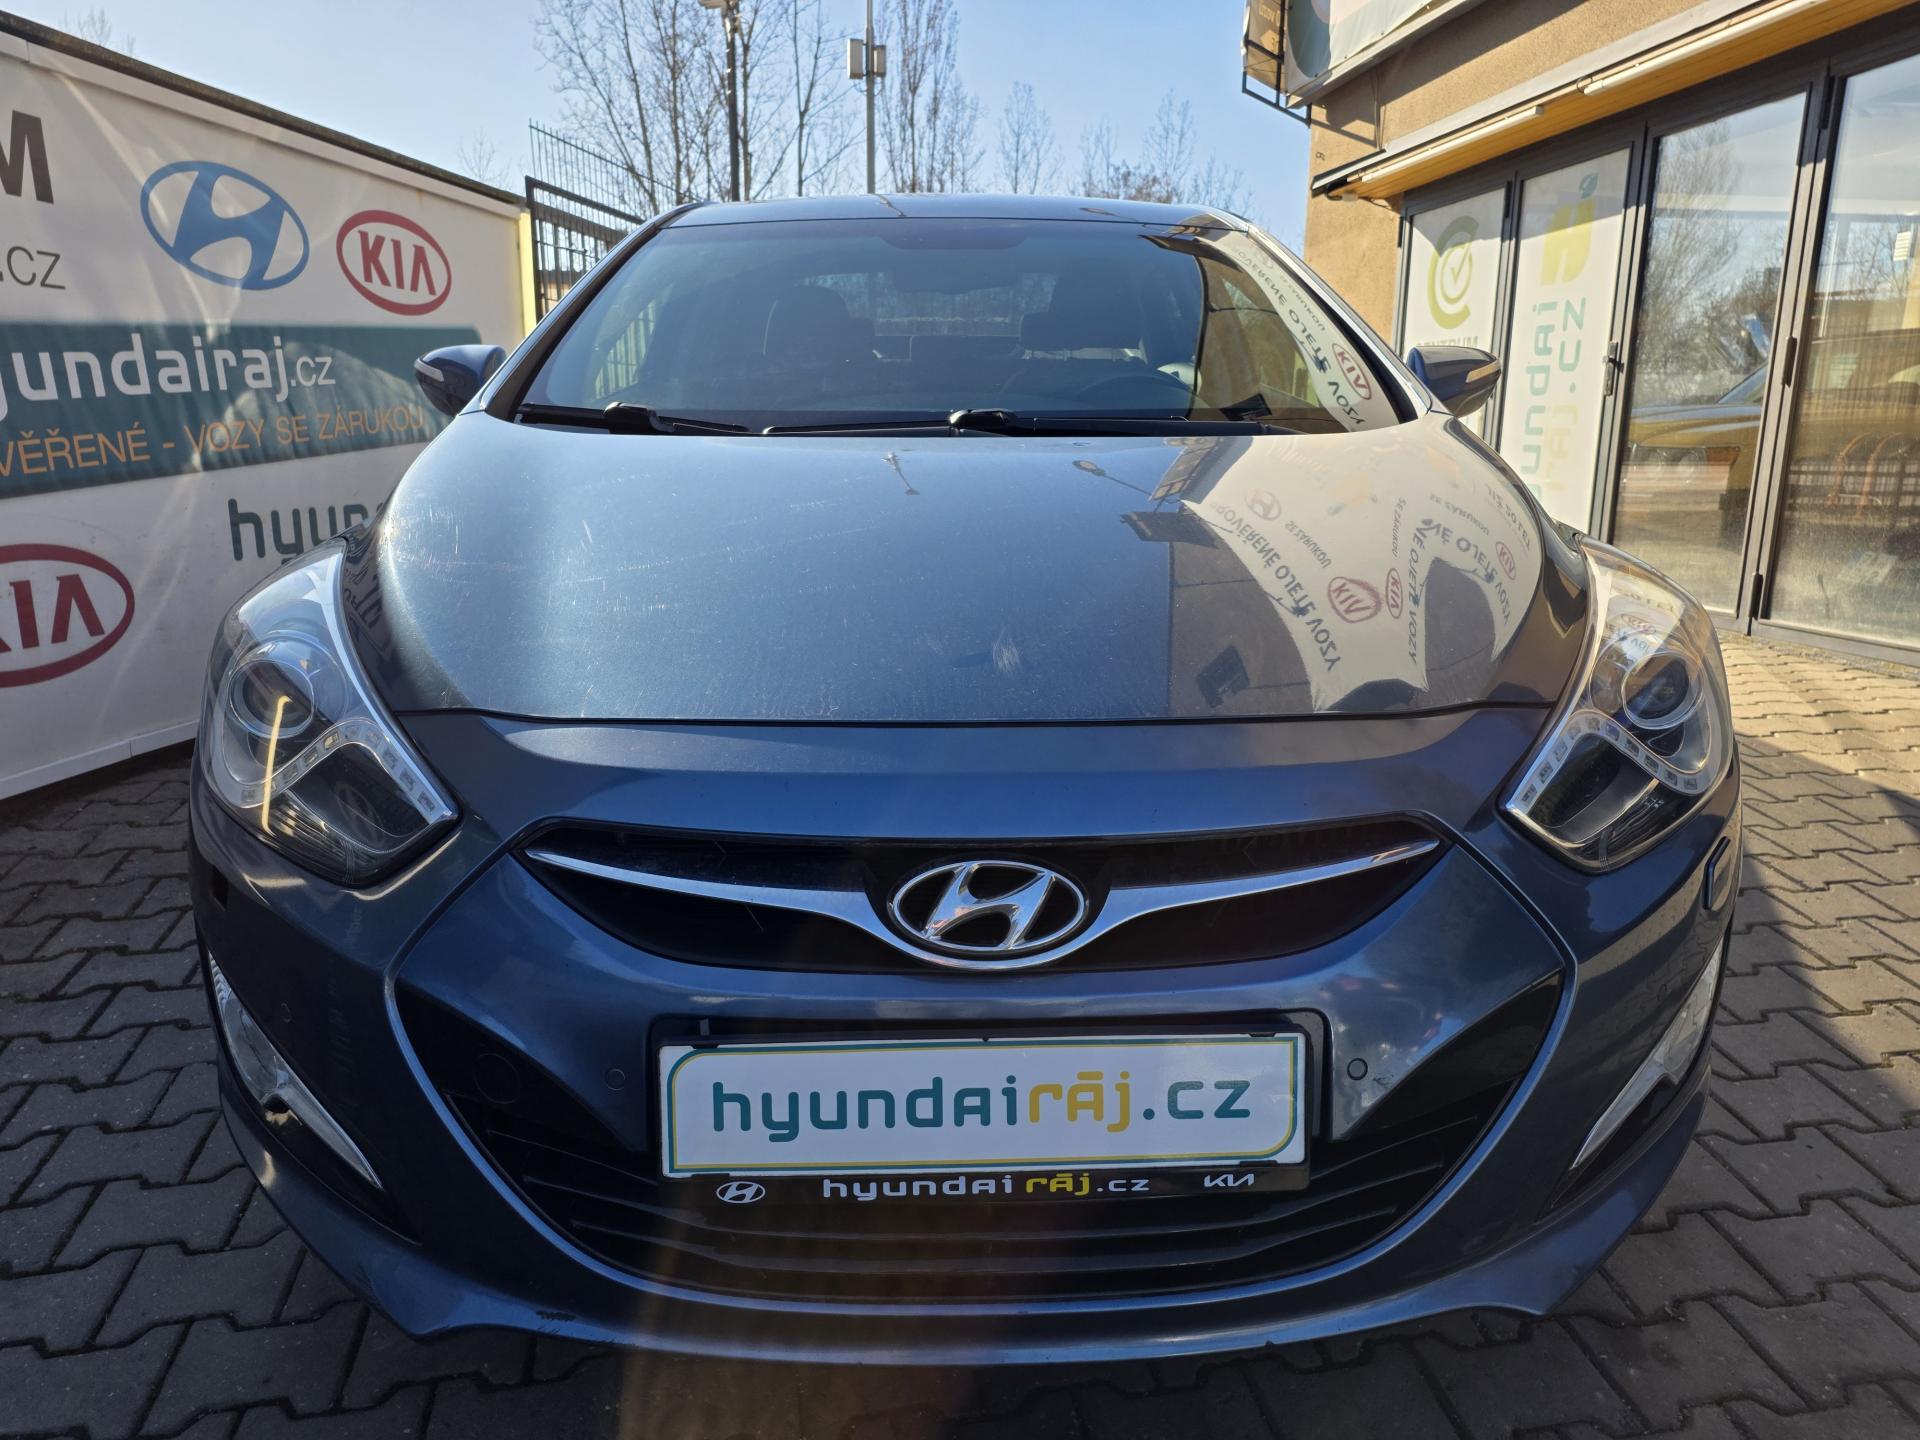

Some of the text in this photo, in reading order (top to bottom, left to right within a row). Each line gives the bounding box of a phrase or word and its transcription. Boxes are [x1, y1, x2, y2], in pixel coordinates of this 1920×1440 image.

[357, 229, 438, 297] KIA
[184, 418, 265, 455] VOZY
[276, 414, 310, 445] SE
[317, 404, 424, 441] ZÁRUKOU
[0, 573, 107, 653] IA
